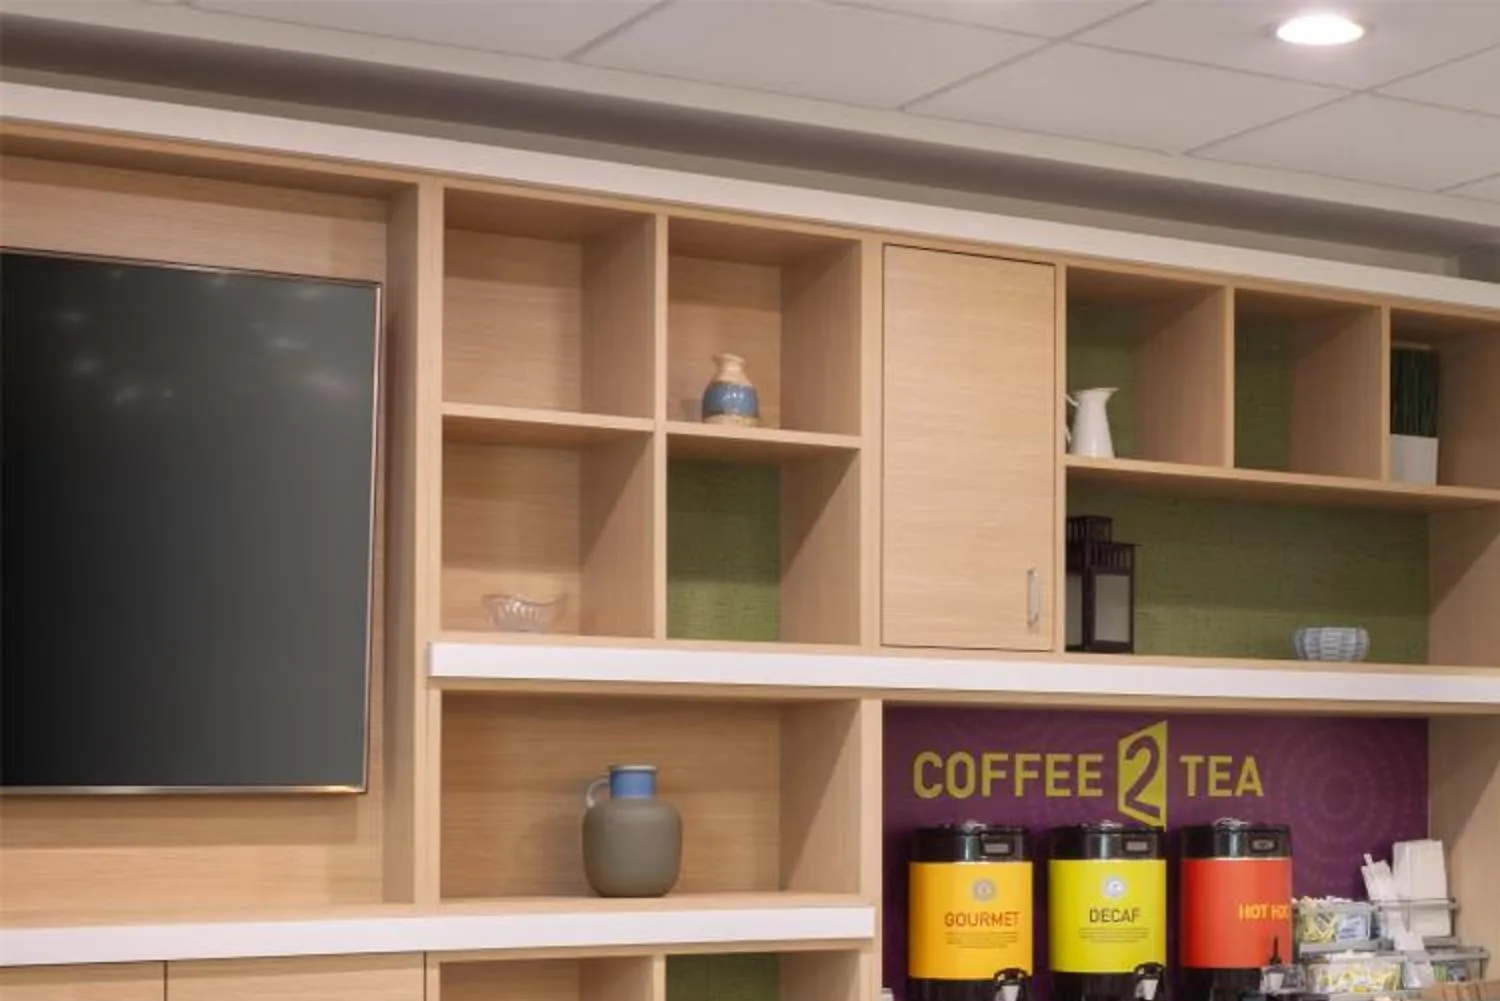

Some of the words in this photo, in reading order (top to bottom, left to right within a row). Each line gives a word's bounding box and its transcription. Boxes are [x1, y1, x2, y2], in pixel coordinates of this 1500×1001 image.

[913, 751, 1104, 799] COFFEE
[1121, 727, 1165, 826] 2
[1180, 755, 1264, 797] TEA
[944, 910, 1022, 928] GOURMET
[1089, 907, 1141, 923] DECAF
[1239, 903, 1268, 921] HOT
